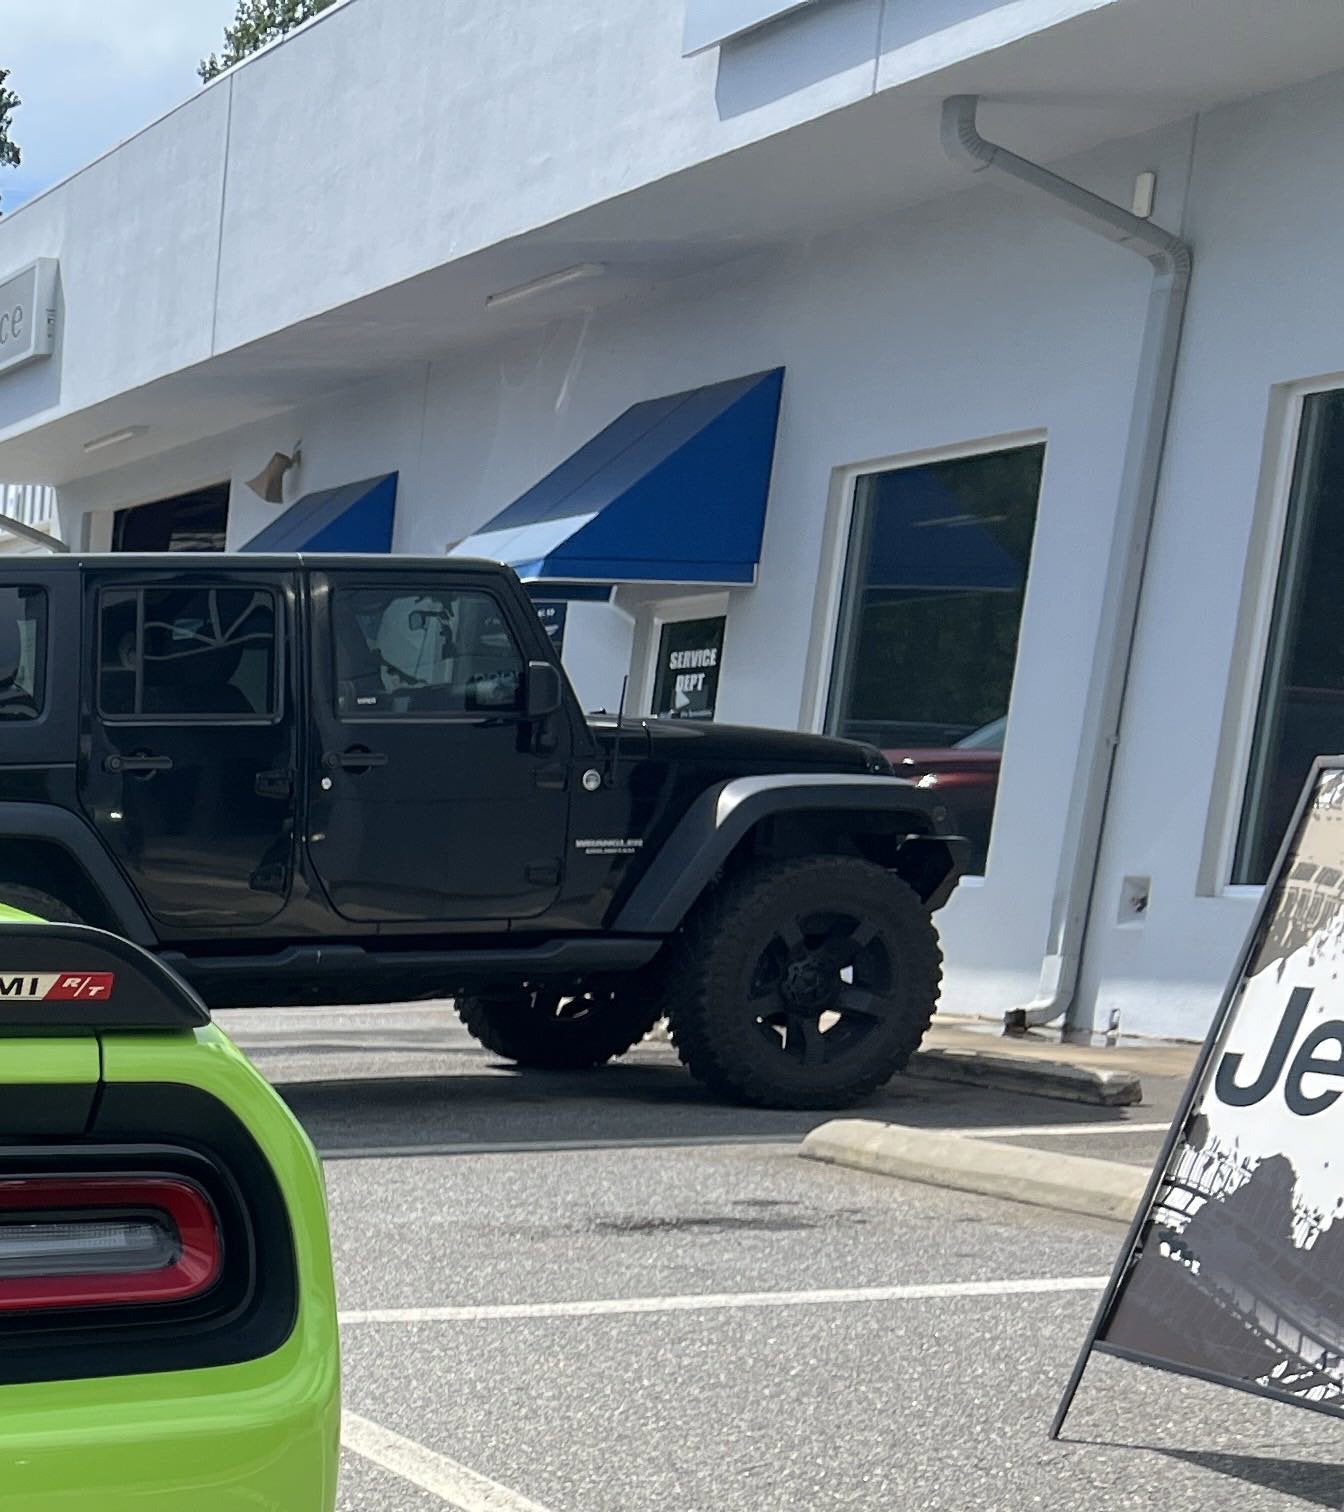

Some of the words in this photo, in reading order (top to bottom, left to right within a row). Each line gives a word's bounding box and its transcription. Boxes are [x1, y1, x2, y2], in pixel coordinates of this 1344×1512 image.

[670, 648, 717, 670] SERVICE
[675, 673, 706, 691] DEPT
[62, 976, 104, 997] R/T
